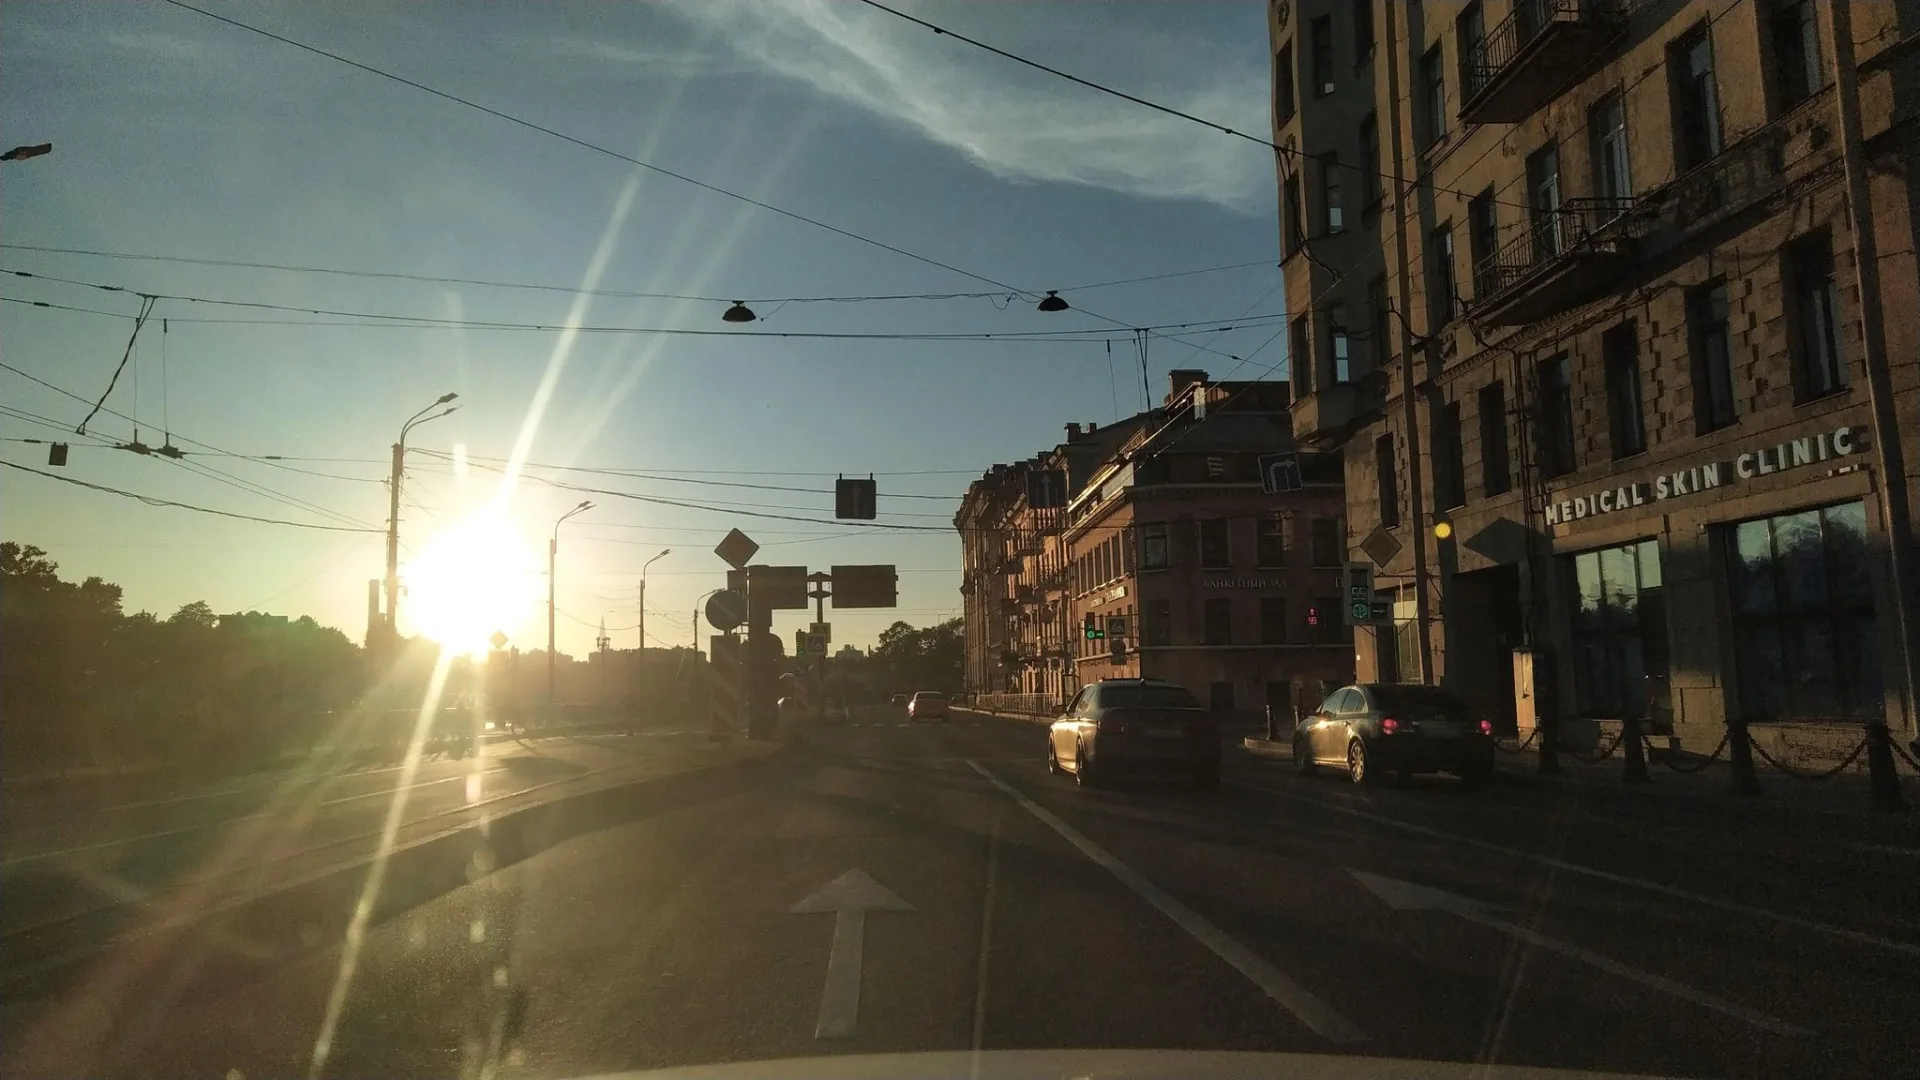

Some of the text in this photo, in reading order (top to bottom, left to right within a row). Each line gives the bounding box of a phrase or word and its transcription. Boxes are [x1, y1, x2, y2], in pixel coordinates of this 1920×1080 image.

[1545, 427, 1853, 525] MEDICAL SKIN CLINIC
